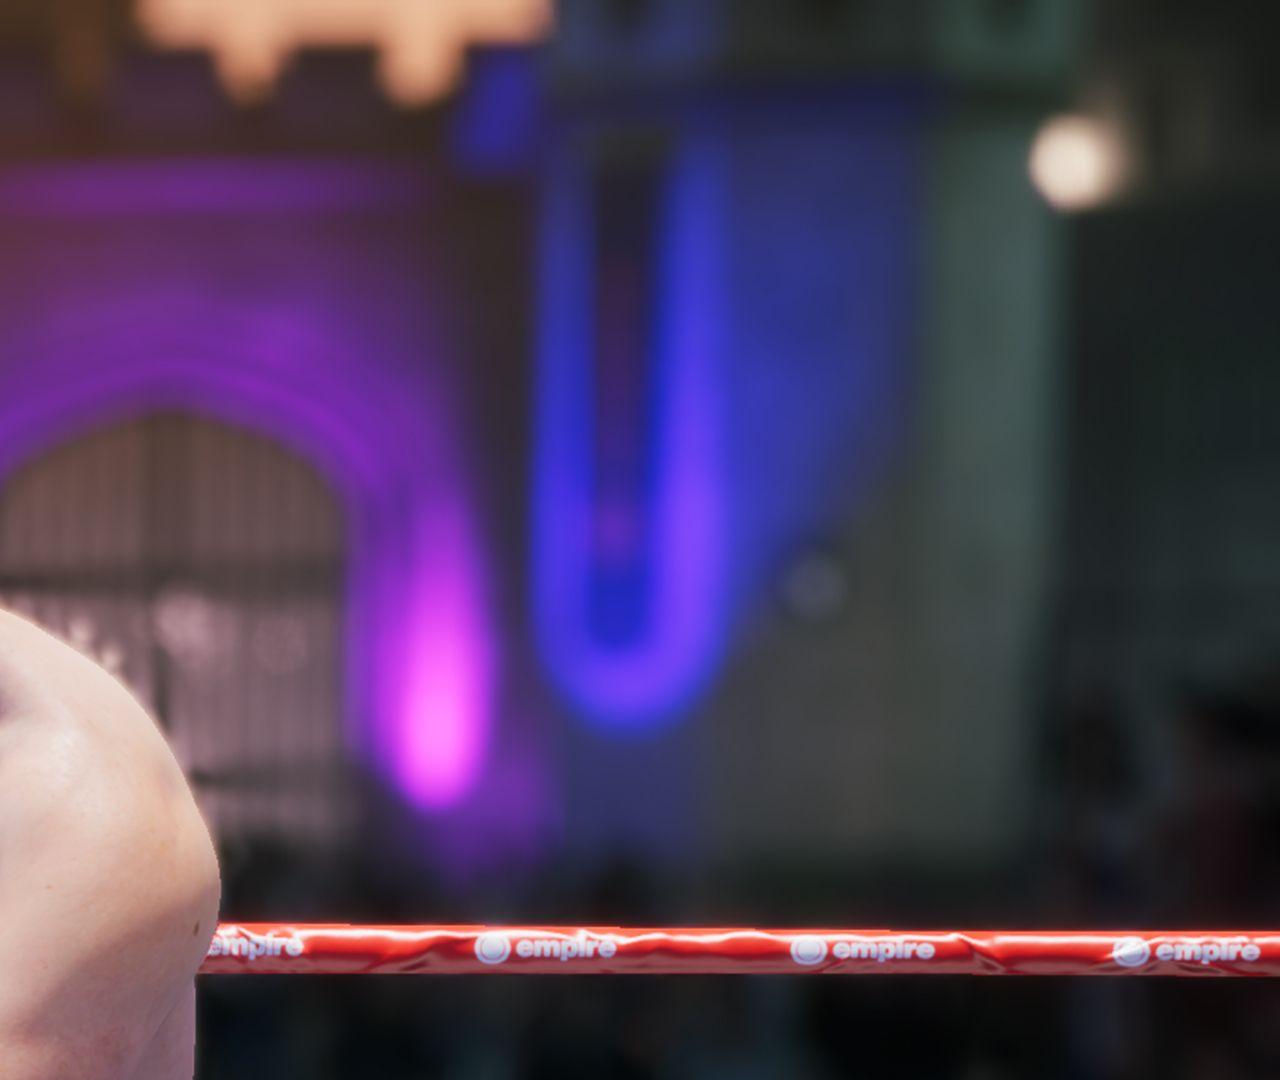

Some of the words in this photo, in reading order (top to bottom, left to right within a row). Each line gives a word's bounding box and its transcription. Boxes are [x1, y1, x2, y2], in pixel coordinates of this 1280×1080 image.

[211, 937, 303, 959] empire
[516, 937, 616, 961] empire
[833, 940, 934, 962] empire
[1156, 941, 1259, 963] empire
